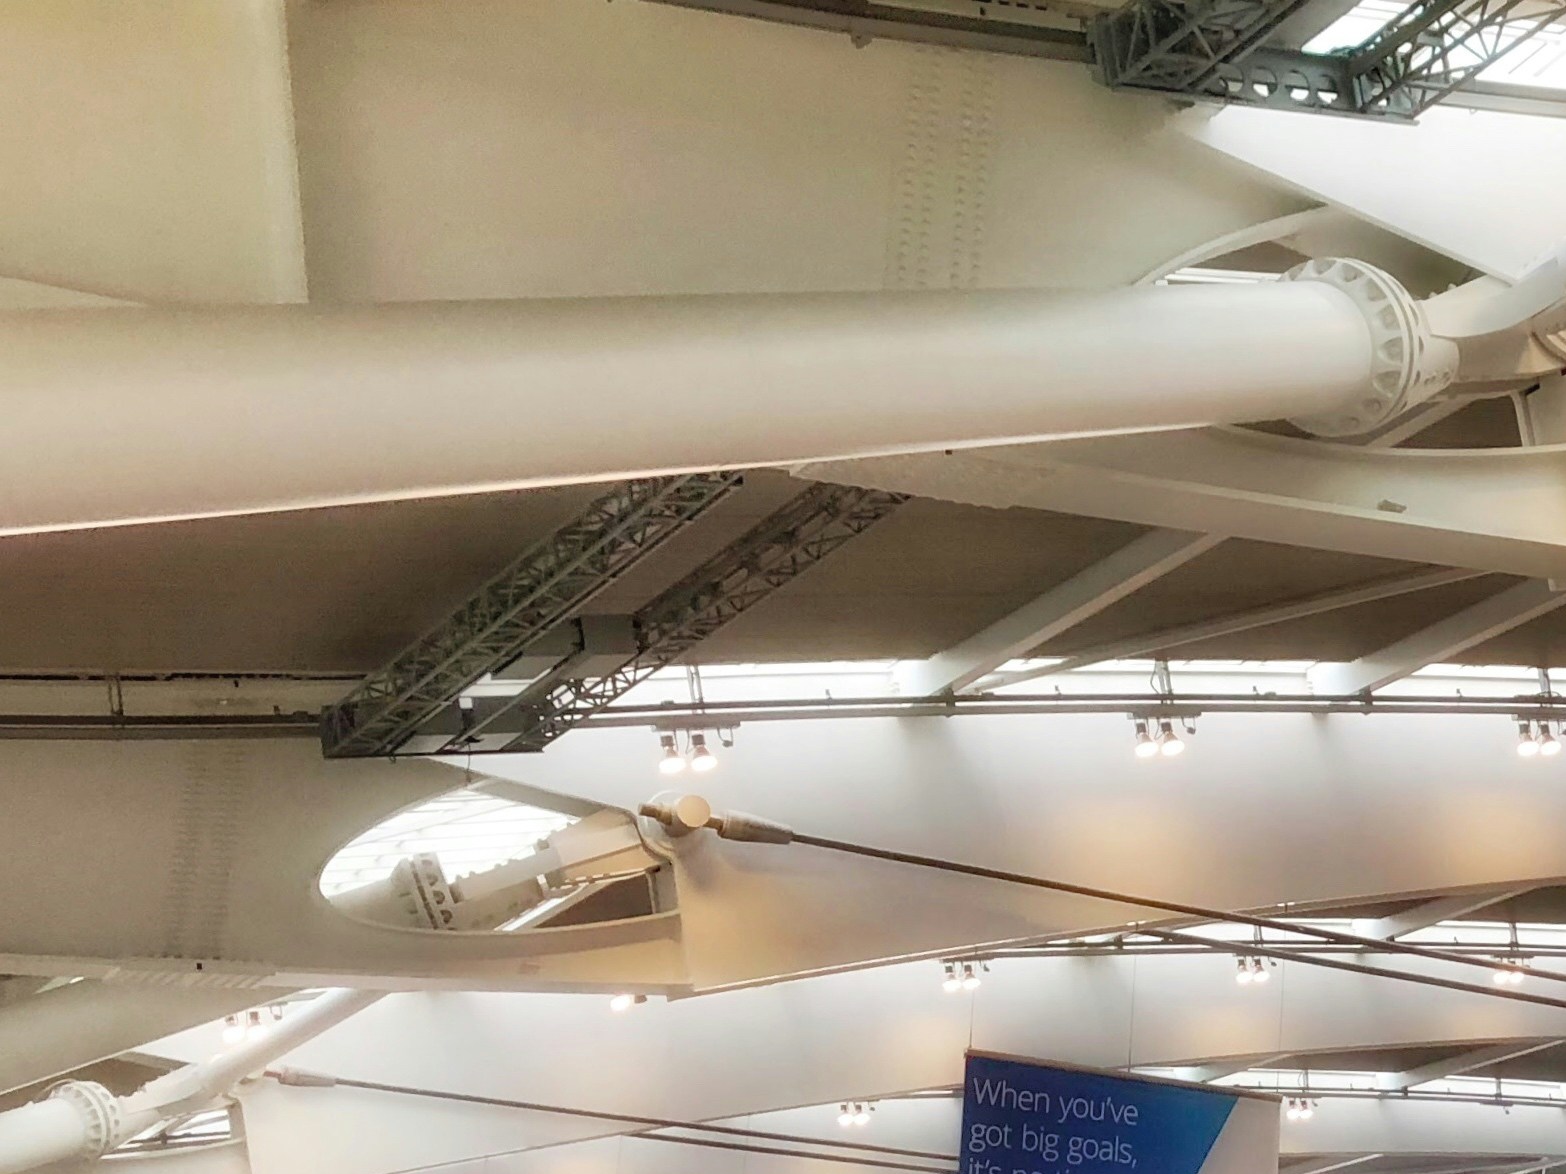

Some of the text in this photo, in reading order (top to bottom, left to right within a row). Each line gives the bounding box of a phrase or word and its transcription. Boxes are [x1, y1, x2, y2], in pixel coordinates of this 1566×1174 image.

[973, 1077, 1139, 1126] When you've
[968, 1123, 1137, 1168] got big goals,
